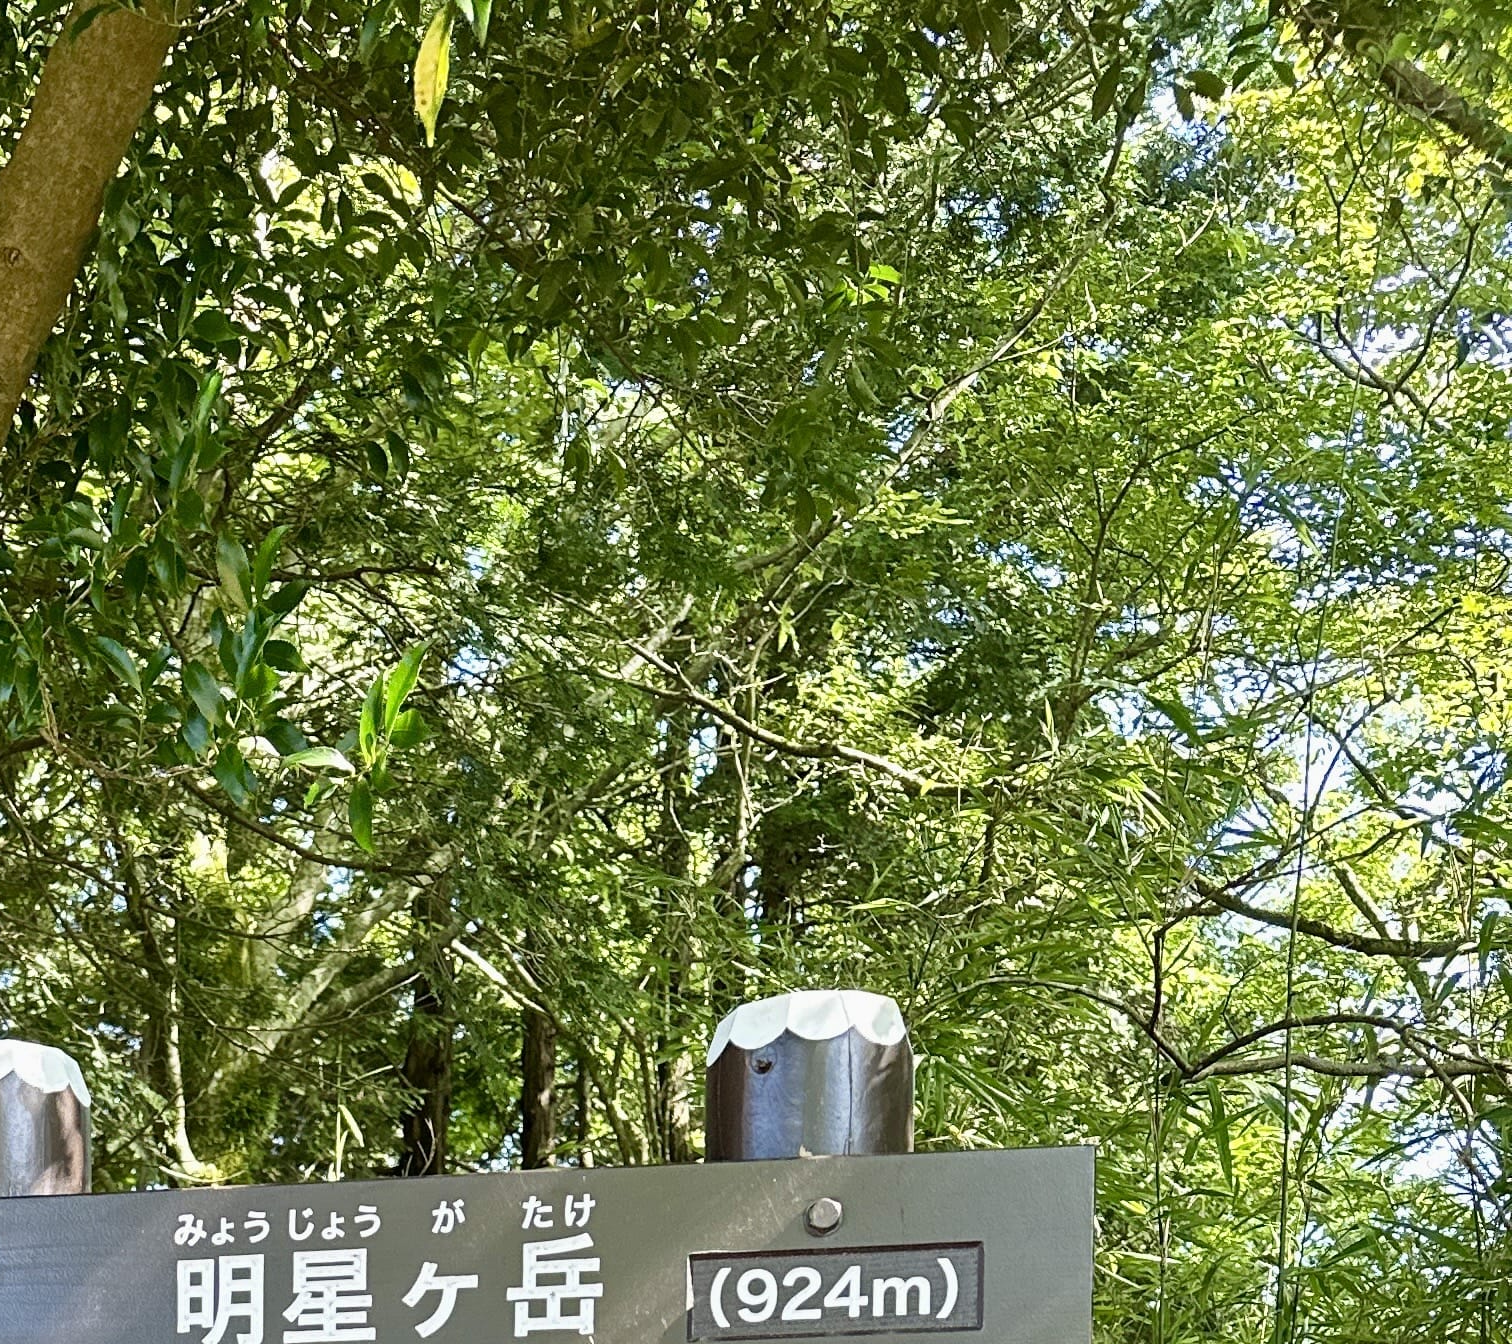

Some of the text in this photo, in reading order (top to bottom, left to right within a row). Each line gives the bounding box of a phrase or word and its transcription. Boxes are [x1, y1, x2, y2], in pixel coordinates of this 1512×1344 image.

[431, 1198, 465, 1234] が
[521, 1193, 596, 1230] たけ
[709, 1256, 960, 1329] (924m)
